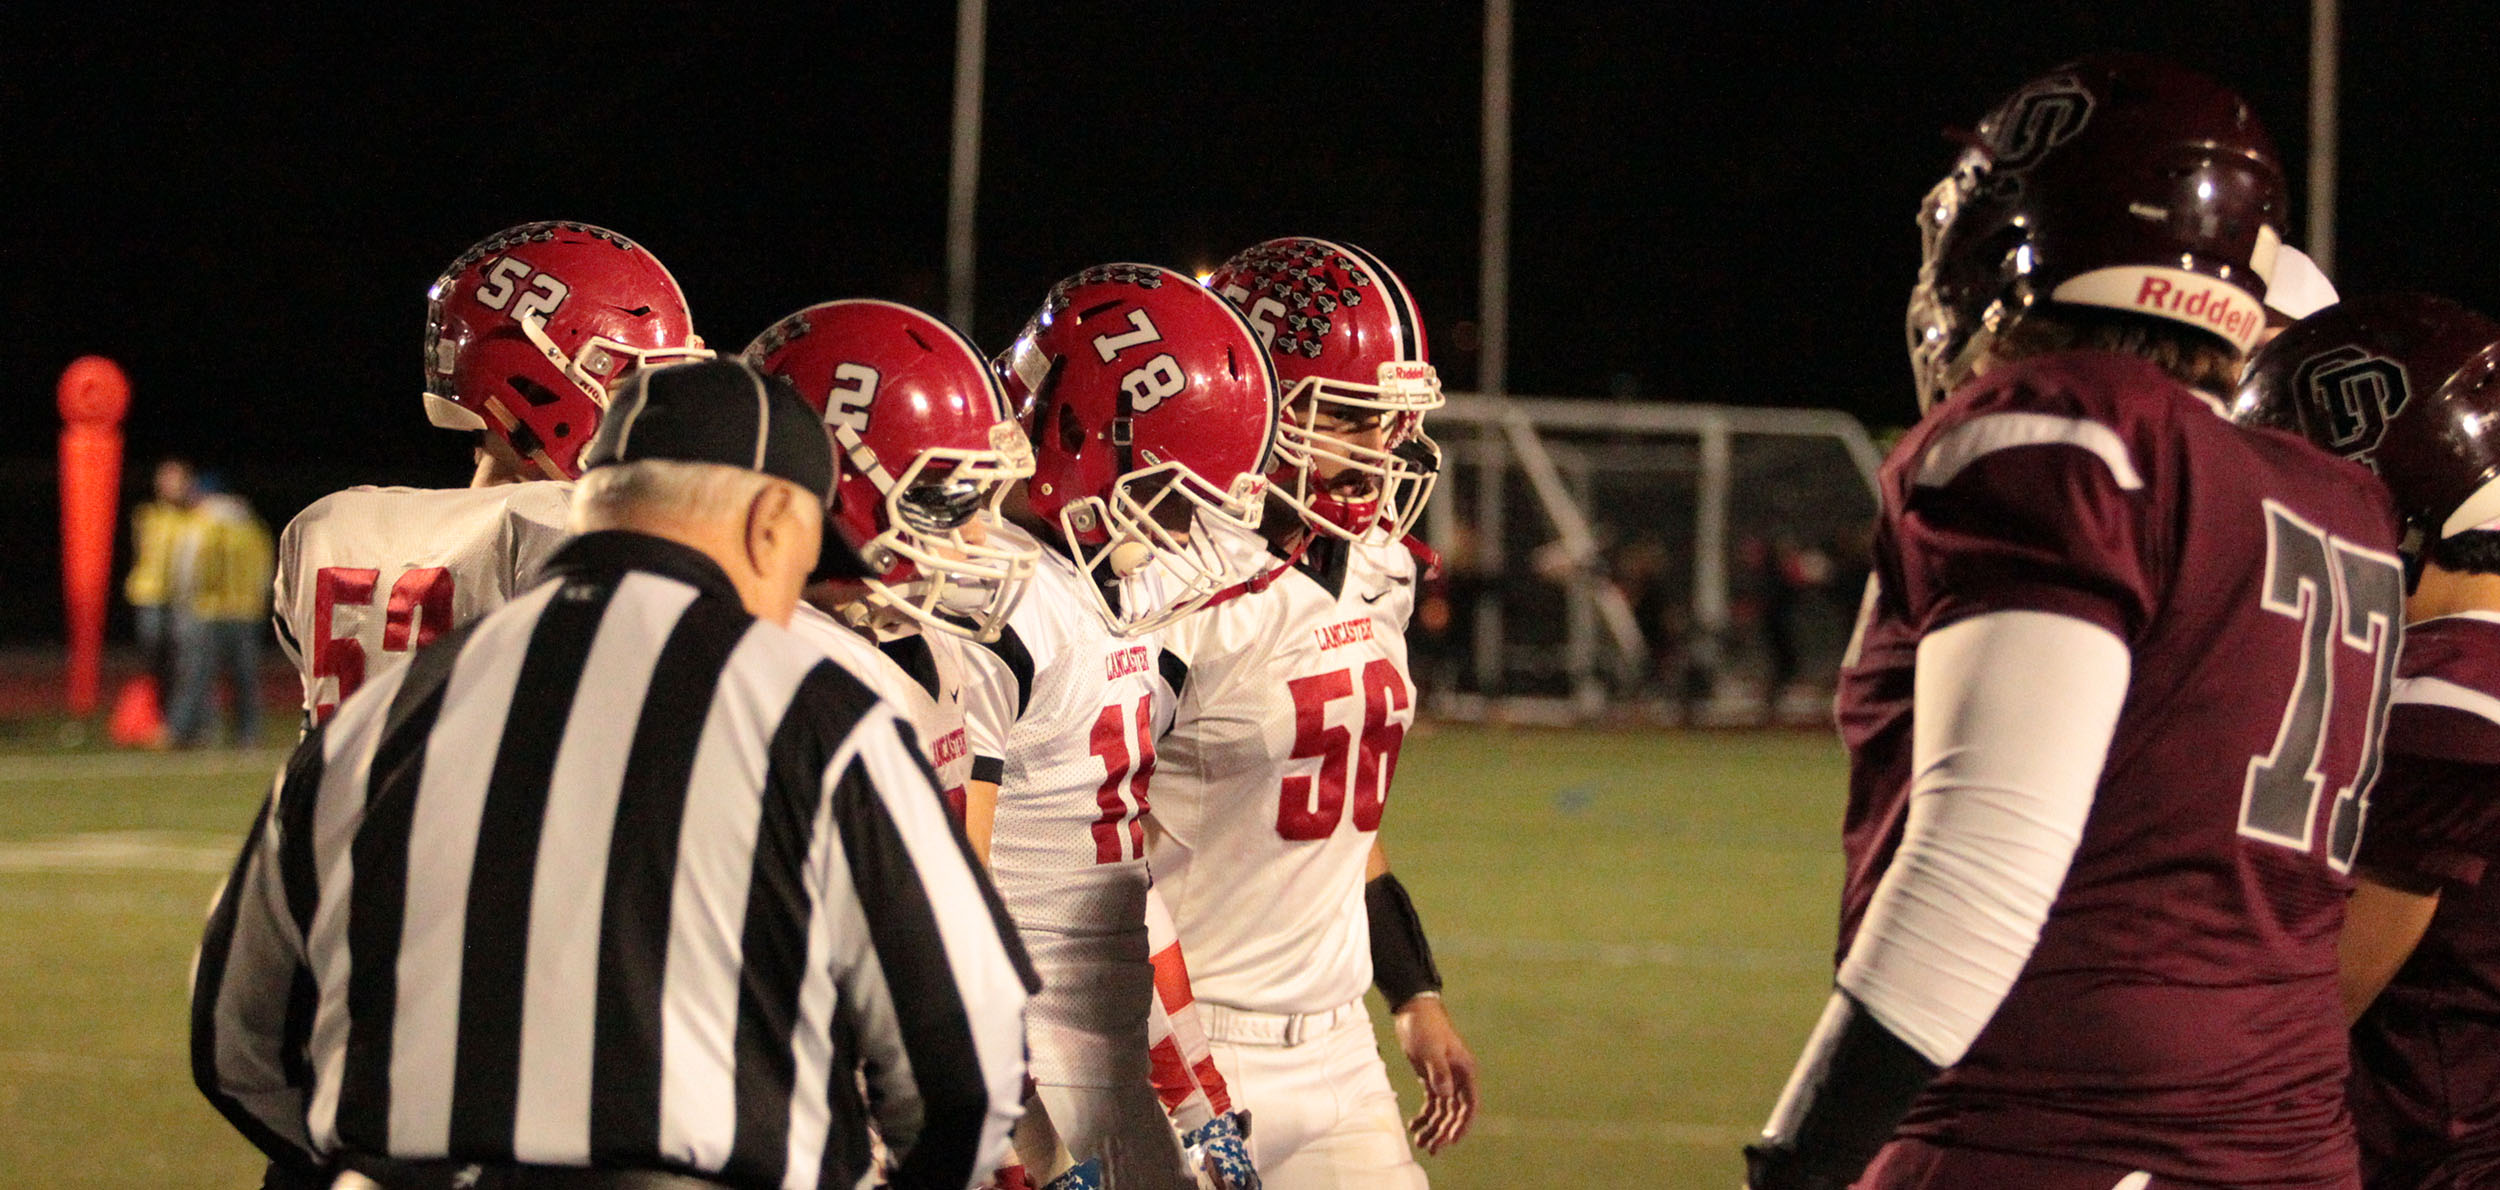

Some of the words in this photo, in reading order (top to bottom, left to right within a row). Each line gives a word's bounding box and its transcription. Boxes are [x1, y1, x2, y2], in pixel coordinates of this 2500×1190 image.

[476, 256, 568, 331] 52
[2136, 276, 2257, 343] Riddell
[1092, 307, 1186, 412] 78
[824, 362, 879, 432] 2
[1105, 645, 1150, 681] LANCASTER
[1313, 617, 1374, 651] LANCASTER
[2236, 499, 2406, 875] 77
[1275, 658, 1408, 841] 56
